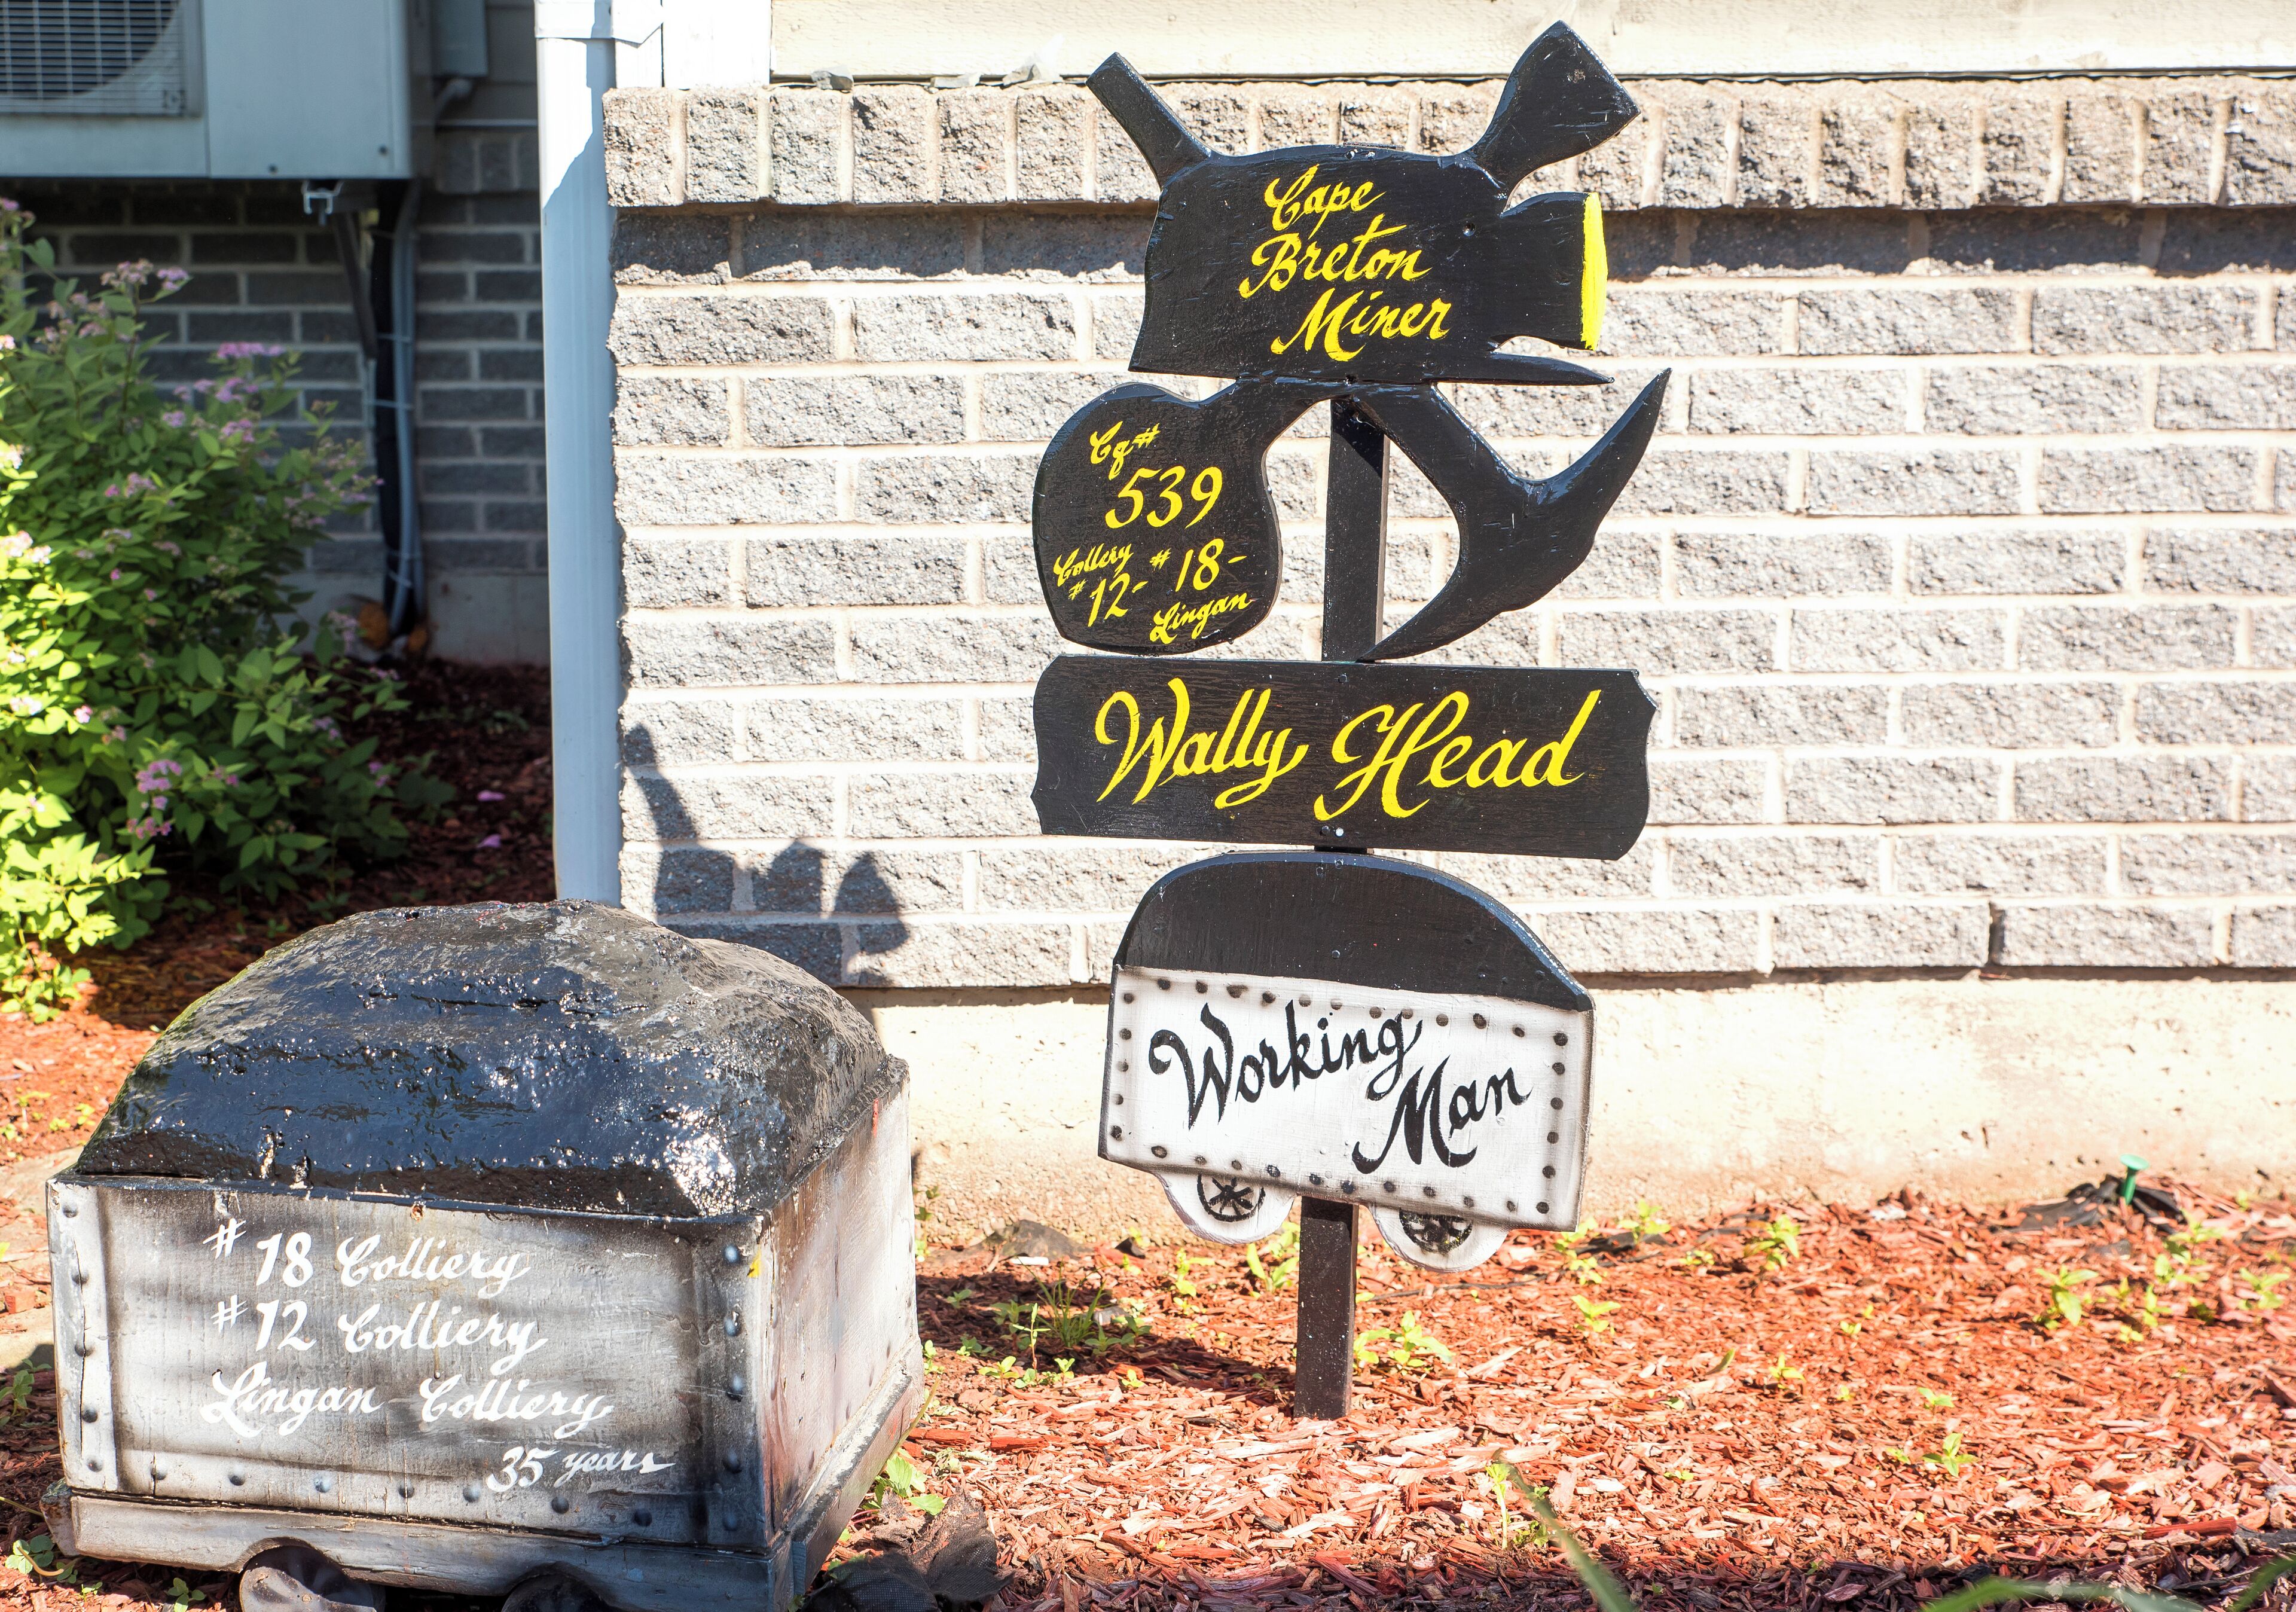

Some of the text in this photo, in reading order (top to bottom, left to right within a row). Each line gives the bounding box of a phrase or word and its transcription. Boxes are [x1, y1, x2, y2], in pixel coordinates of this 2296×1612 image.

[1264, 164, 1387, 240] Cape
[1238, 213, 1433, 299] Breton
[1270, 288, 1452, 362] Miner
[1105, 466, 1223, 529] 539
[1149, 591, 1254, 645] Lingan
[1095, 677, 1602, 822] Wally Head
[1148, 999, 1423, 1130] Working
[1351, 1055, 1534, 1174] Man
[336, 1231, 532, 1299] Colliery
[337, 1300, 549, 1376] Colliery
[199, 1360, 615, 1439] Lingan Colliery
[485, 1445, 676, 1493] 35 years
